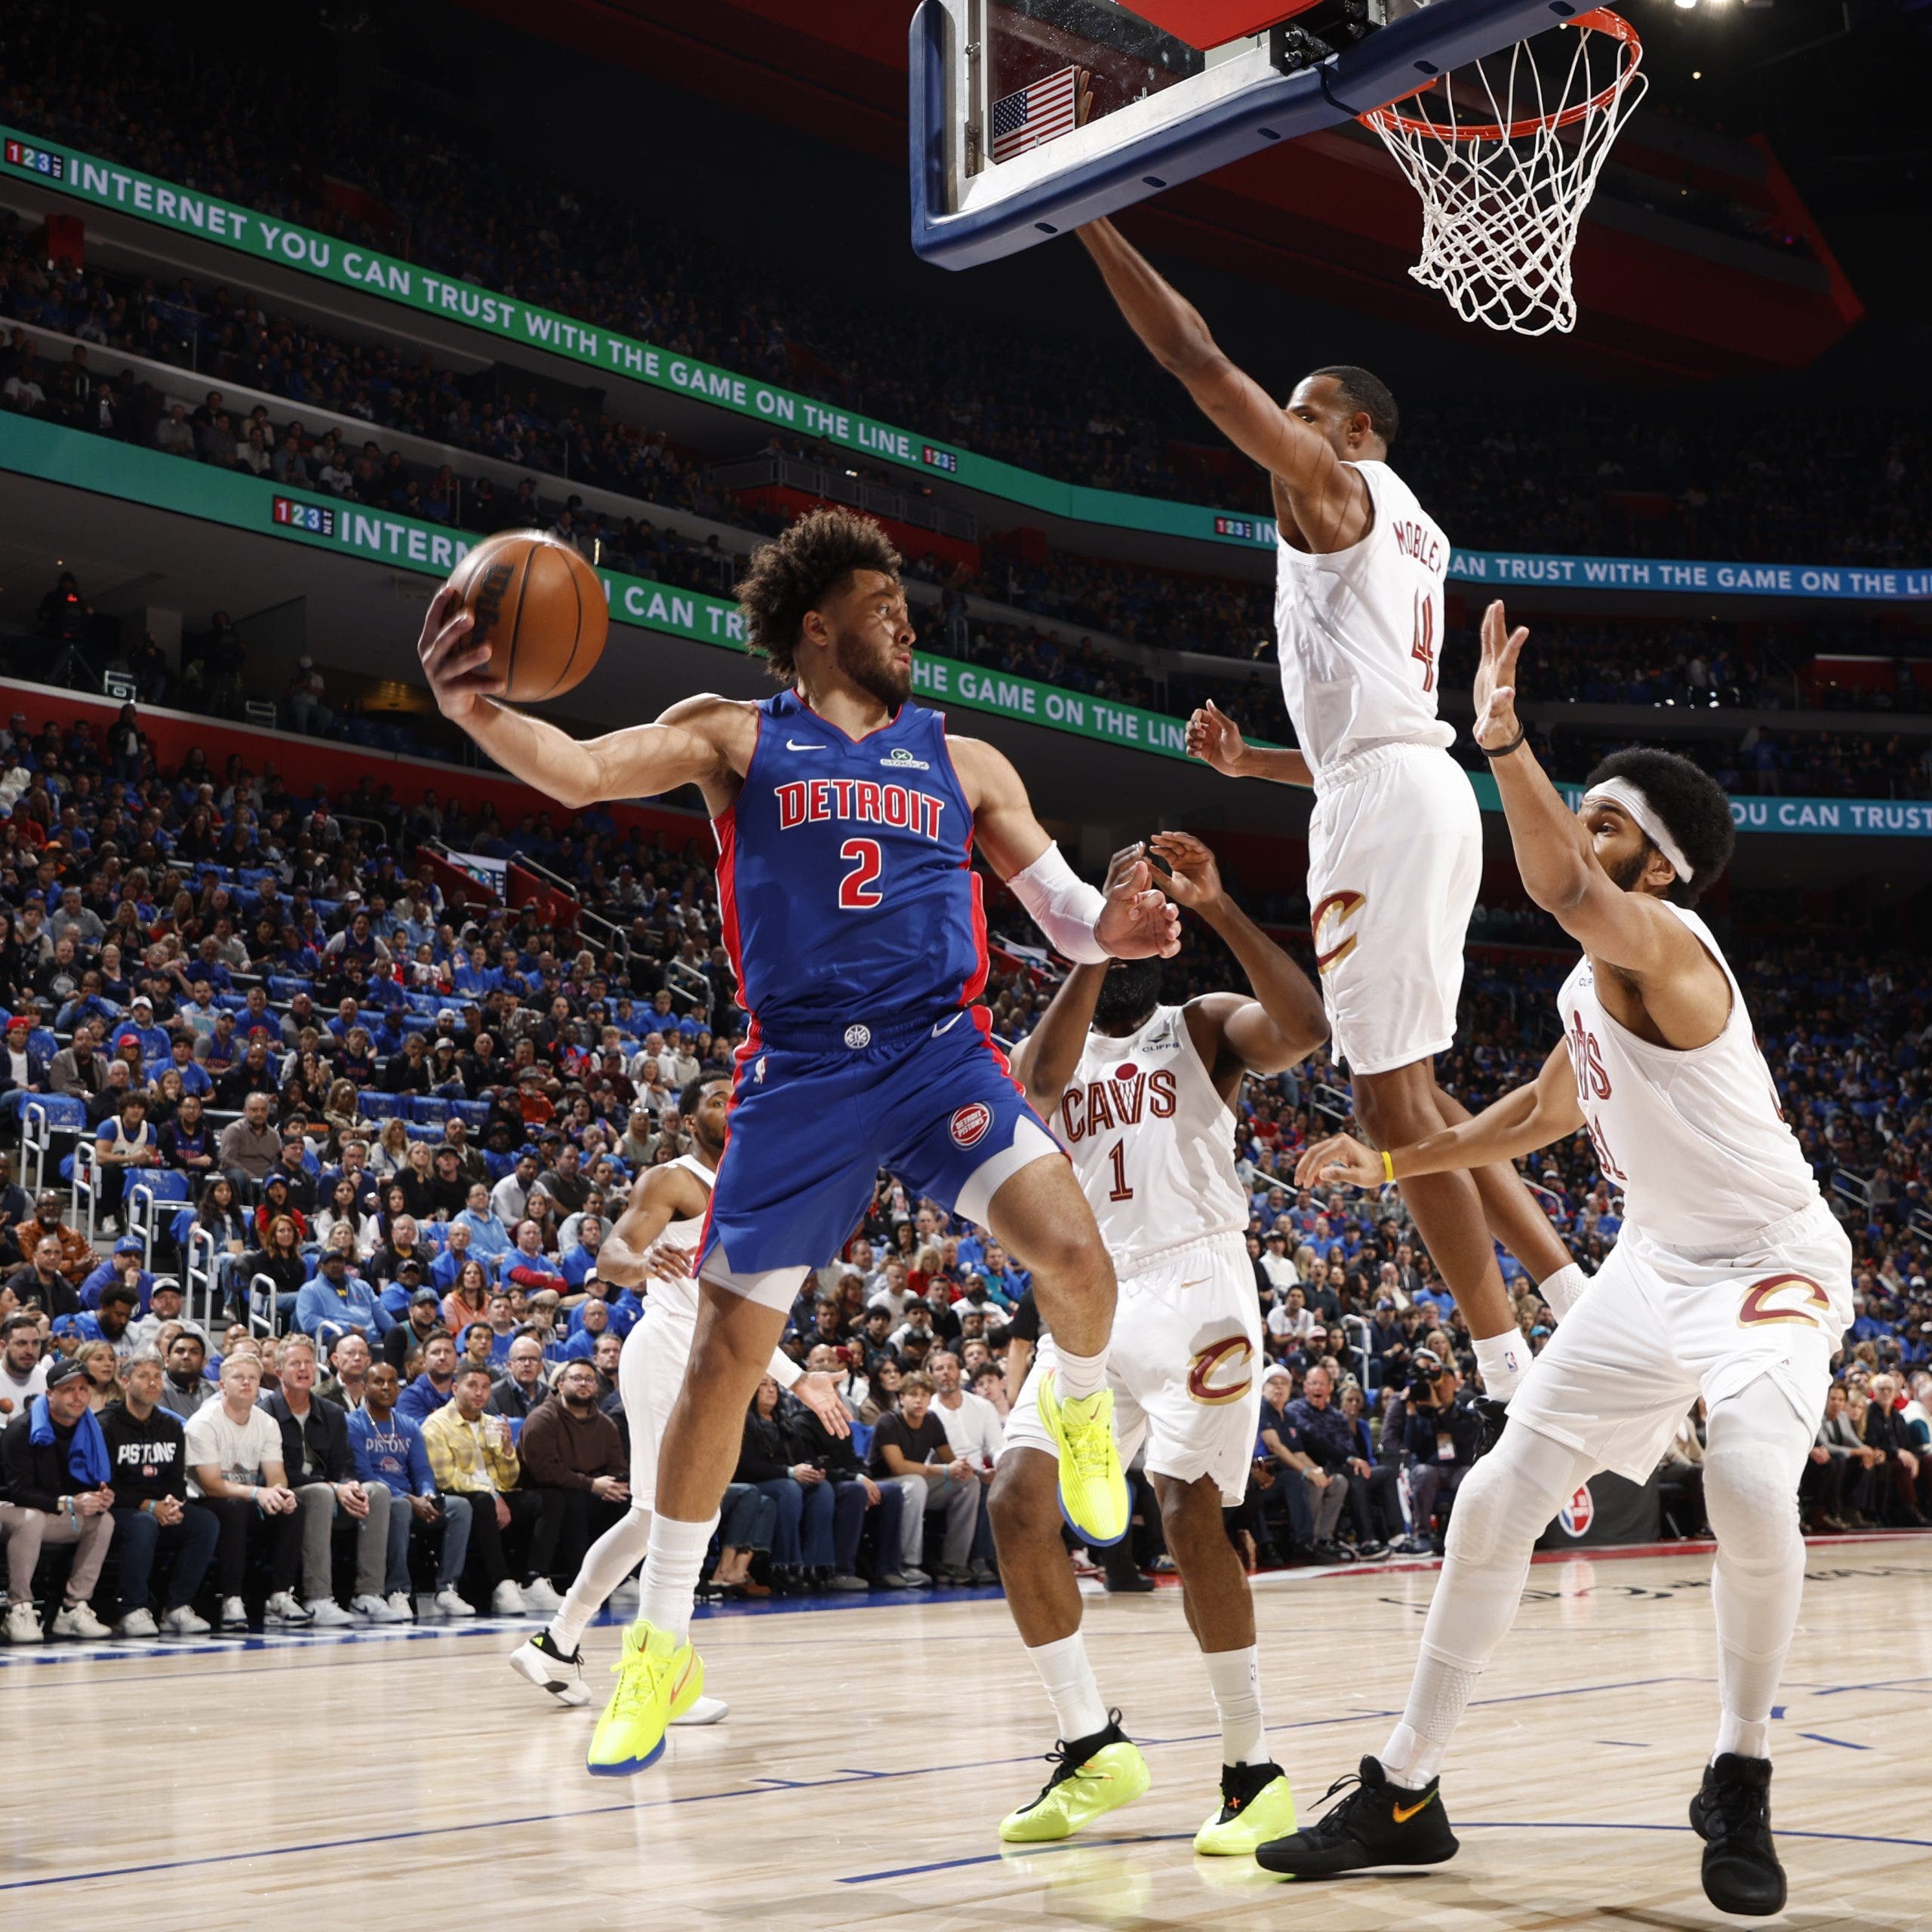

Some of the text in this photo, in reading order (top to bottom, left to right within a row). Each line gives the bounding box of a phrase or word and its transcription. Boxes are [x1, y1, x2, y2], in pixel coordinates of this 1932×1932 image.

[11, 143, 50, 172] 123
[70, 158, 247, 241] INTERNET
[260, 222, 330, 269] YOU
[343, 253, 411, 295] CAN
[423, 277, 515, 329] TRUST
[525, 311, 598, 356] WITH
[608, 339, 660, 377] THE
[669, 361, 746, 406] GAME
[756, 389, 795, 422] ON
[803, 405, 849, 439] THE
[858, 422, 918, 462] LINE.
[1448, 557, 1486, 577] AN
[1495, 558, 1576, 581] TRUST
[1584, 562, 1650, 584] WITH
[1659, 565, 1708, 586] THE
[1717, 568, 1792, 590] GAME
[1801, 571, 1840, 592] ON
[1847, 573, 1897, 594] THE
[1906, 574, 1932, 595] LI
[278, 500, 320, 529] 123
[625, 586, 694, 629] CAN
[913, 659, 948, 692] HE
[958, 672, 1036, 714] GAME
[1044, 694, 1084, 726] ON
[1092, 705, 1139, 740] THE
[1148, 719, 1185, 752] LIN
[1411, 586, 1433, 693] 4
[774, 779, 945, 841] DETROIT
[1729, 802, 1932, 829] OU CAN TRUST
[838, 838, 883, 909] 2
[1142, 1042, 1180, 1053] CLIFFS
[1061, 1069, 1176, 1143] CAVS
[1109, 1138, 1134, 1201] 1
